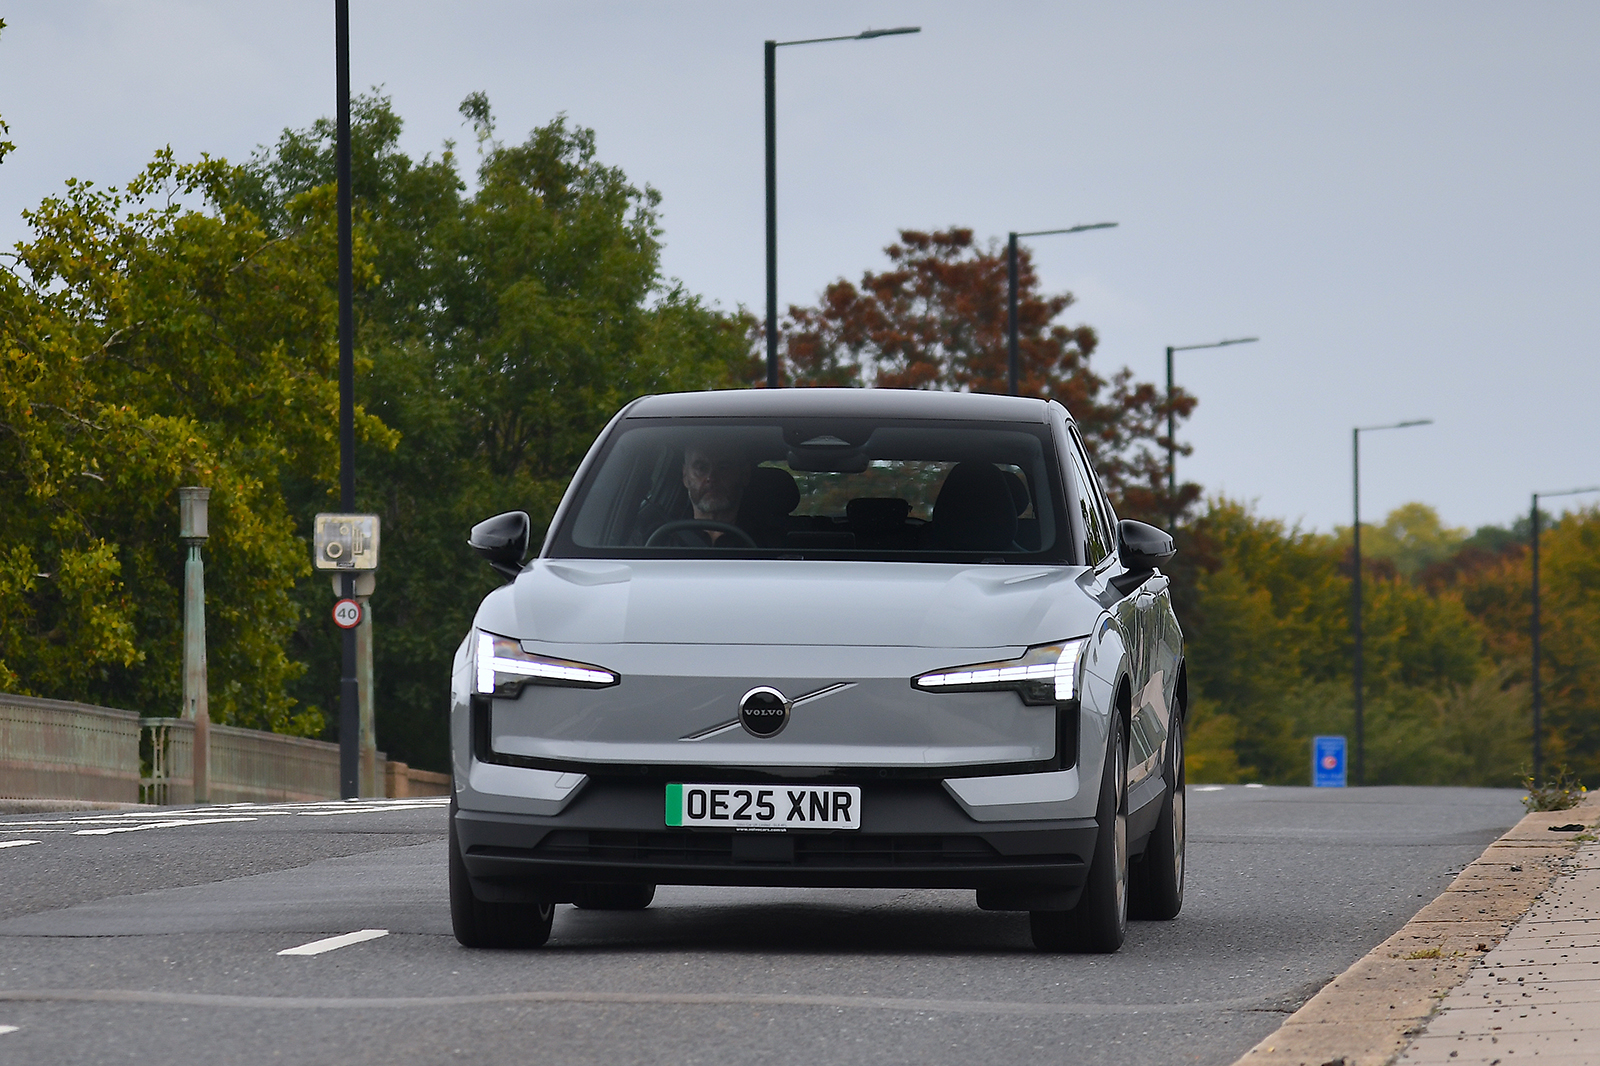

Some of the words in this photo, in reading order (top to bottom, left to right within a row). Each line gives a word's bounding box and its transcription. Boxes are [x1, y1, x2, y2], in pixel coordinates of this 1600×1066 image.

[337, 608, 357, 619] 40
[687, 789, 775, 821] OE25
[786, 790, 852, 822] XNR
